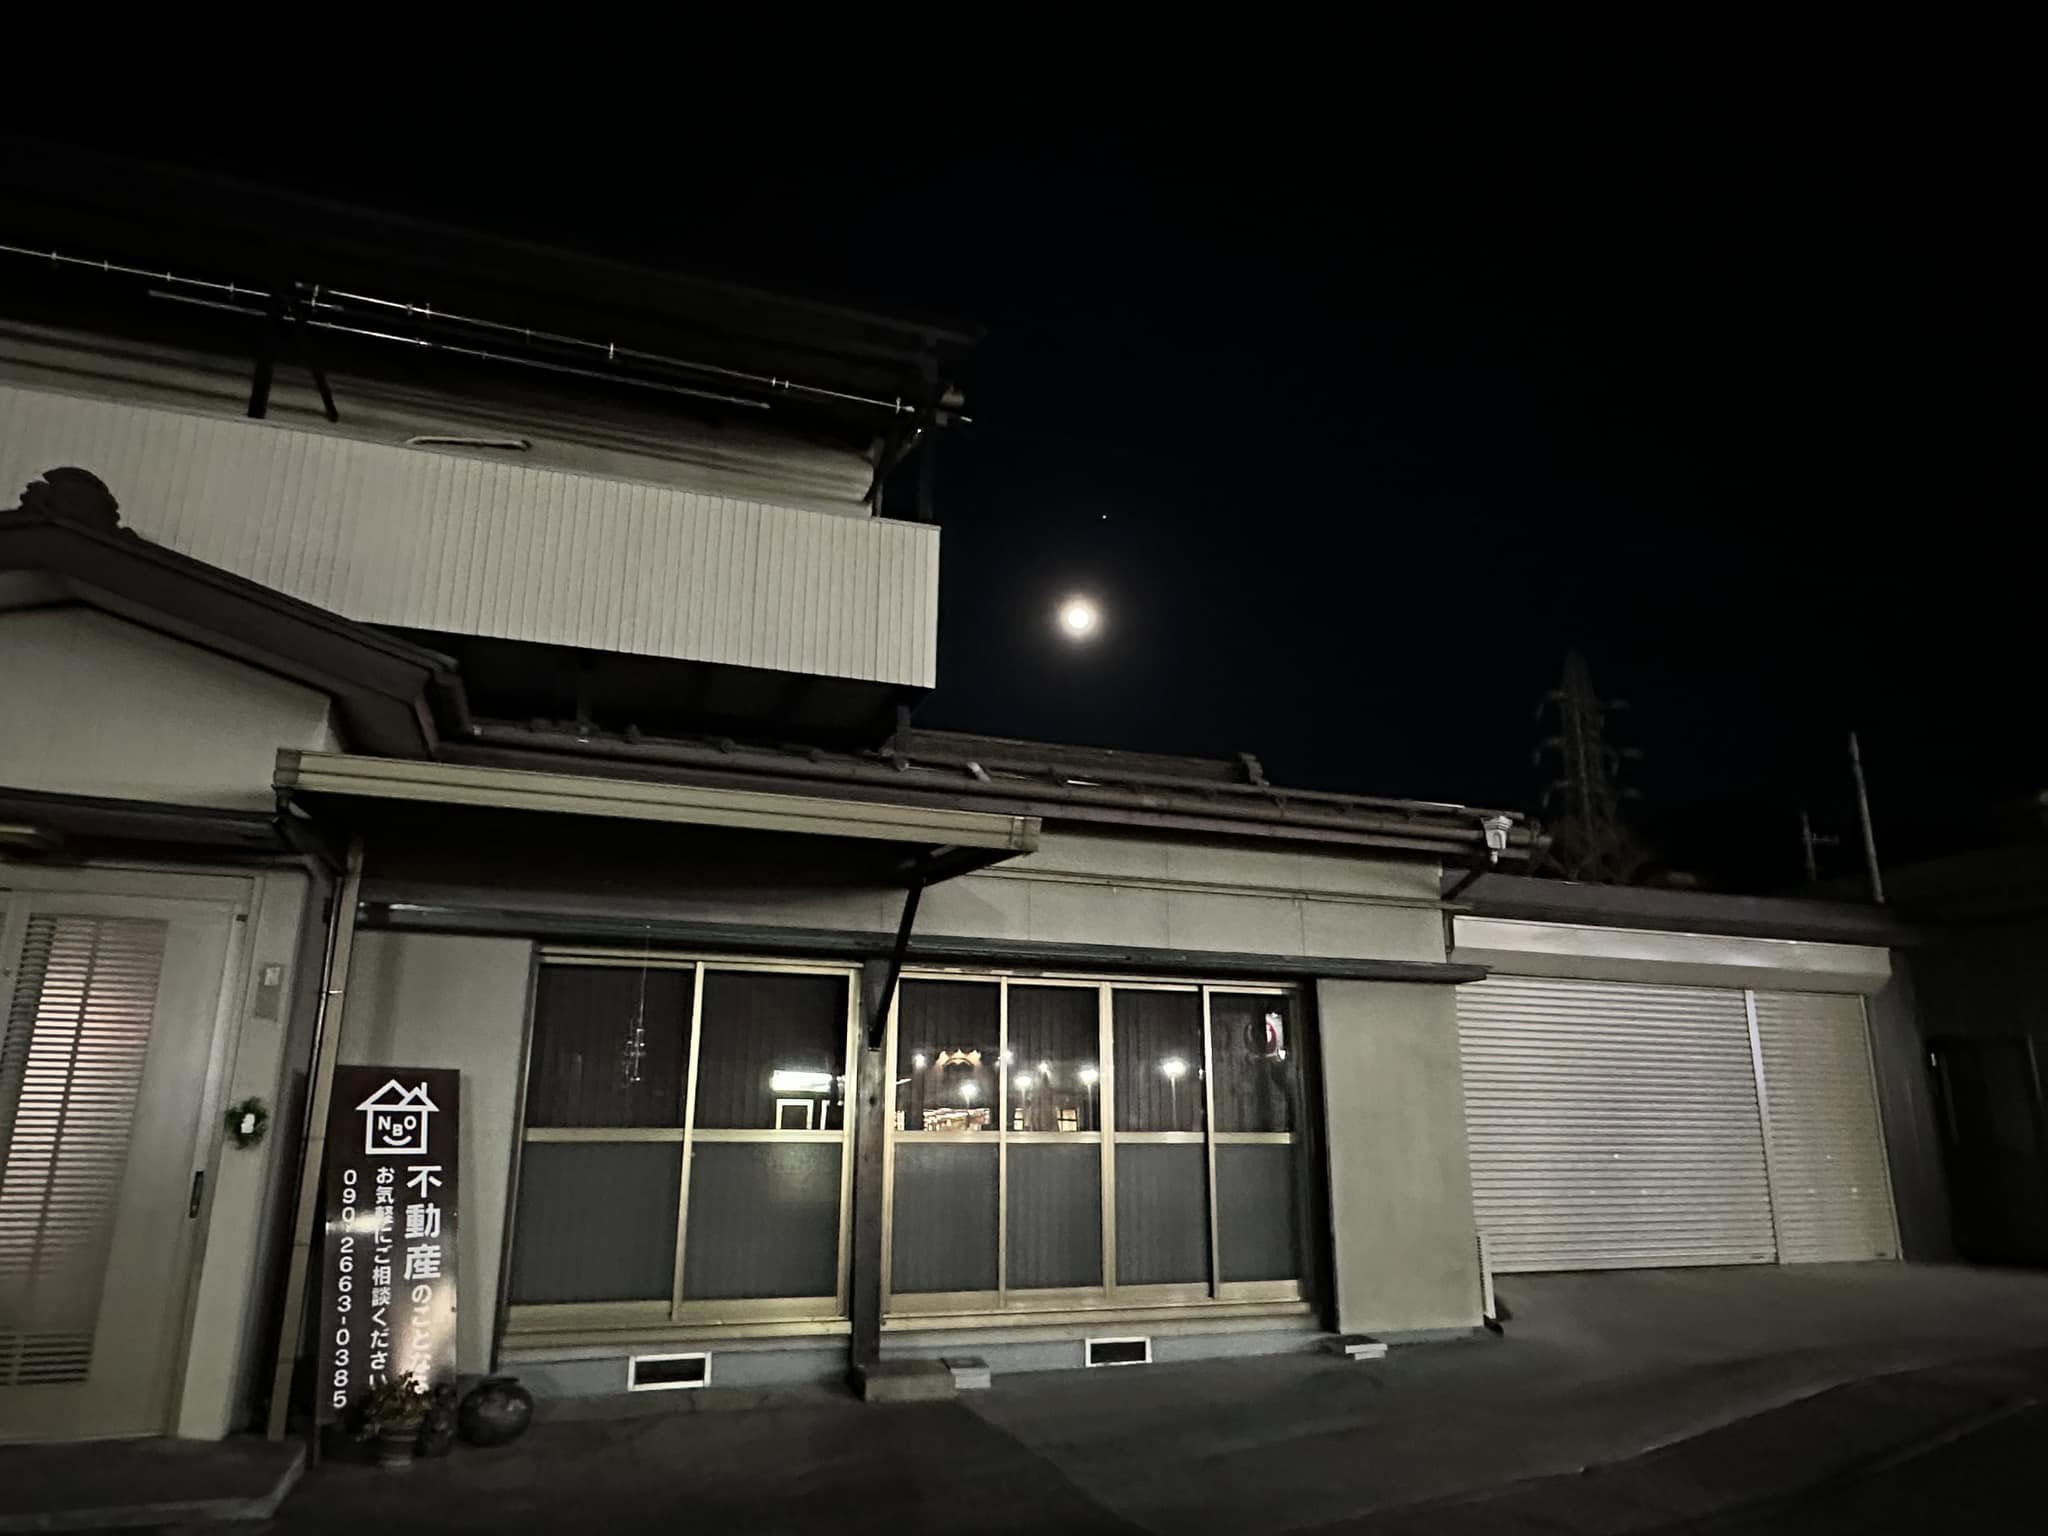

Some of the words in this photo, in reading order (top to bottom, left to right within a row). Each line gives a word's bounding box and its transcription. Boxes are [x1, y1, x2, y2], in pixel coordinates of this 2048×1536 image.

[378, 1115, 417, 1137] NBO
[369, 1166, 395, 1390] お気軽にご相談ください
